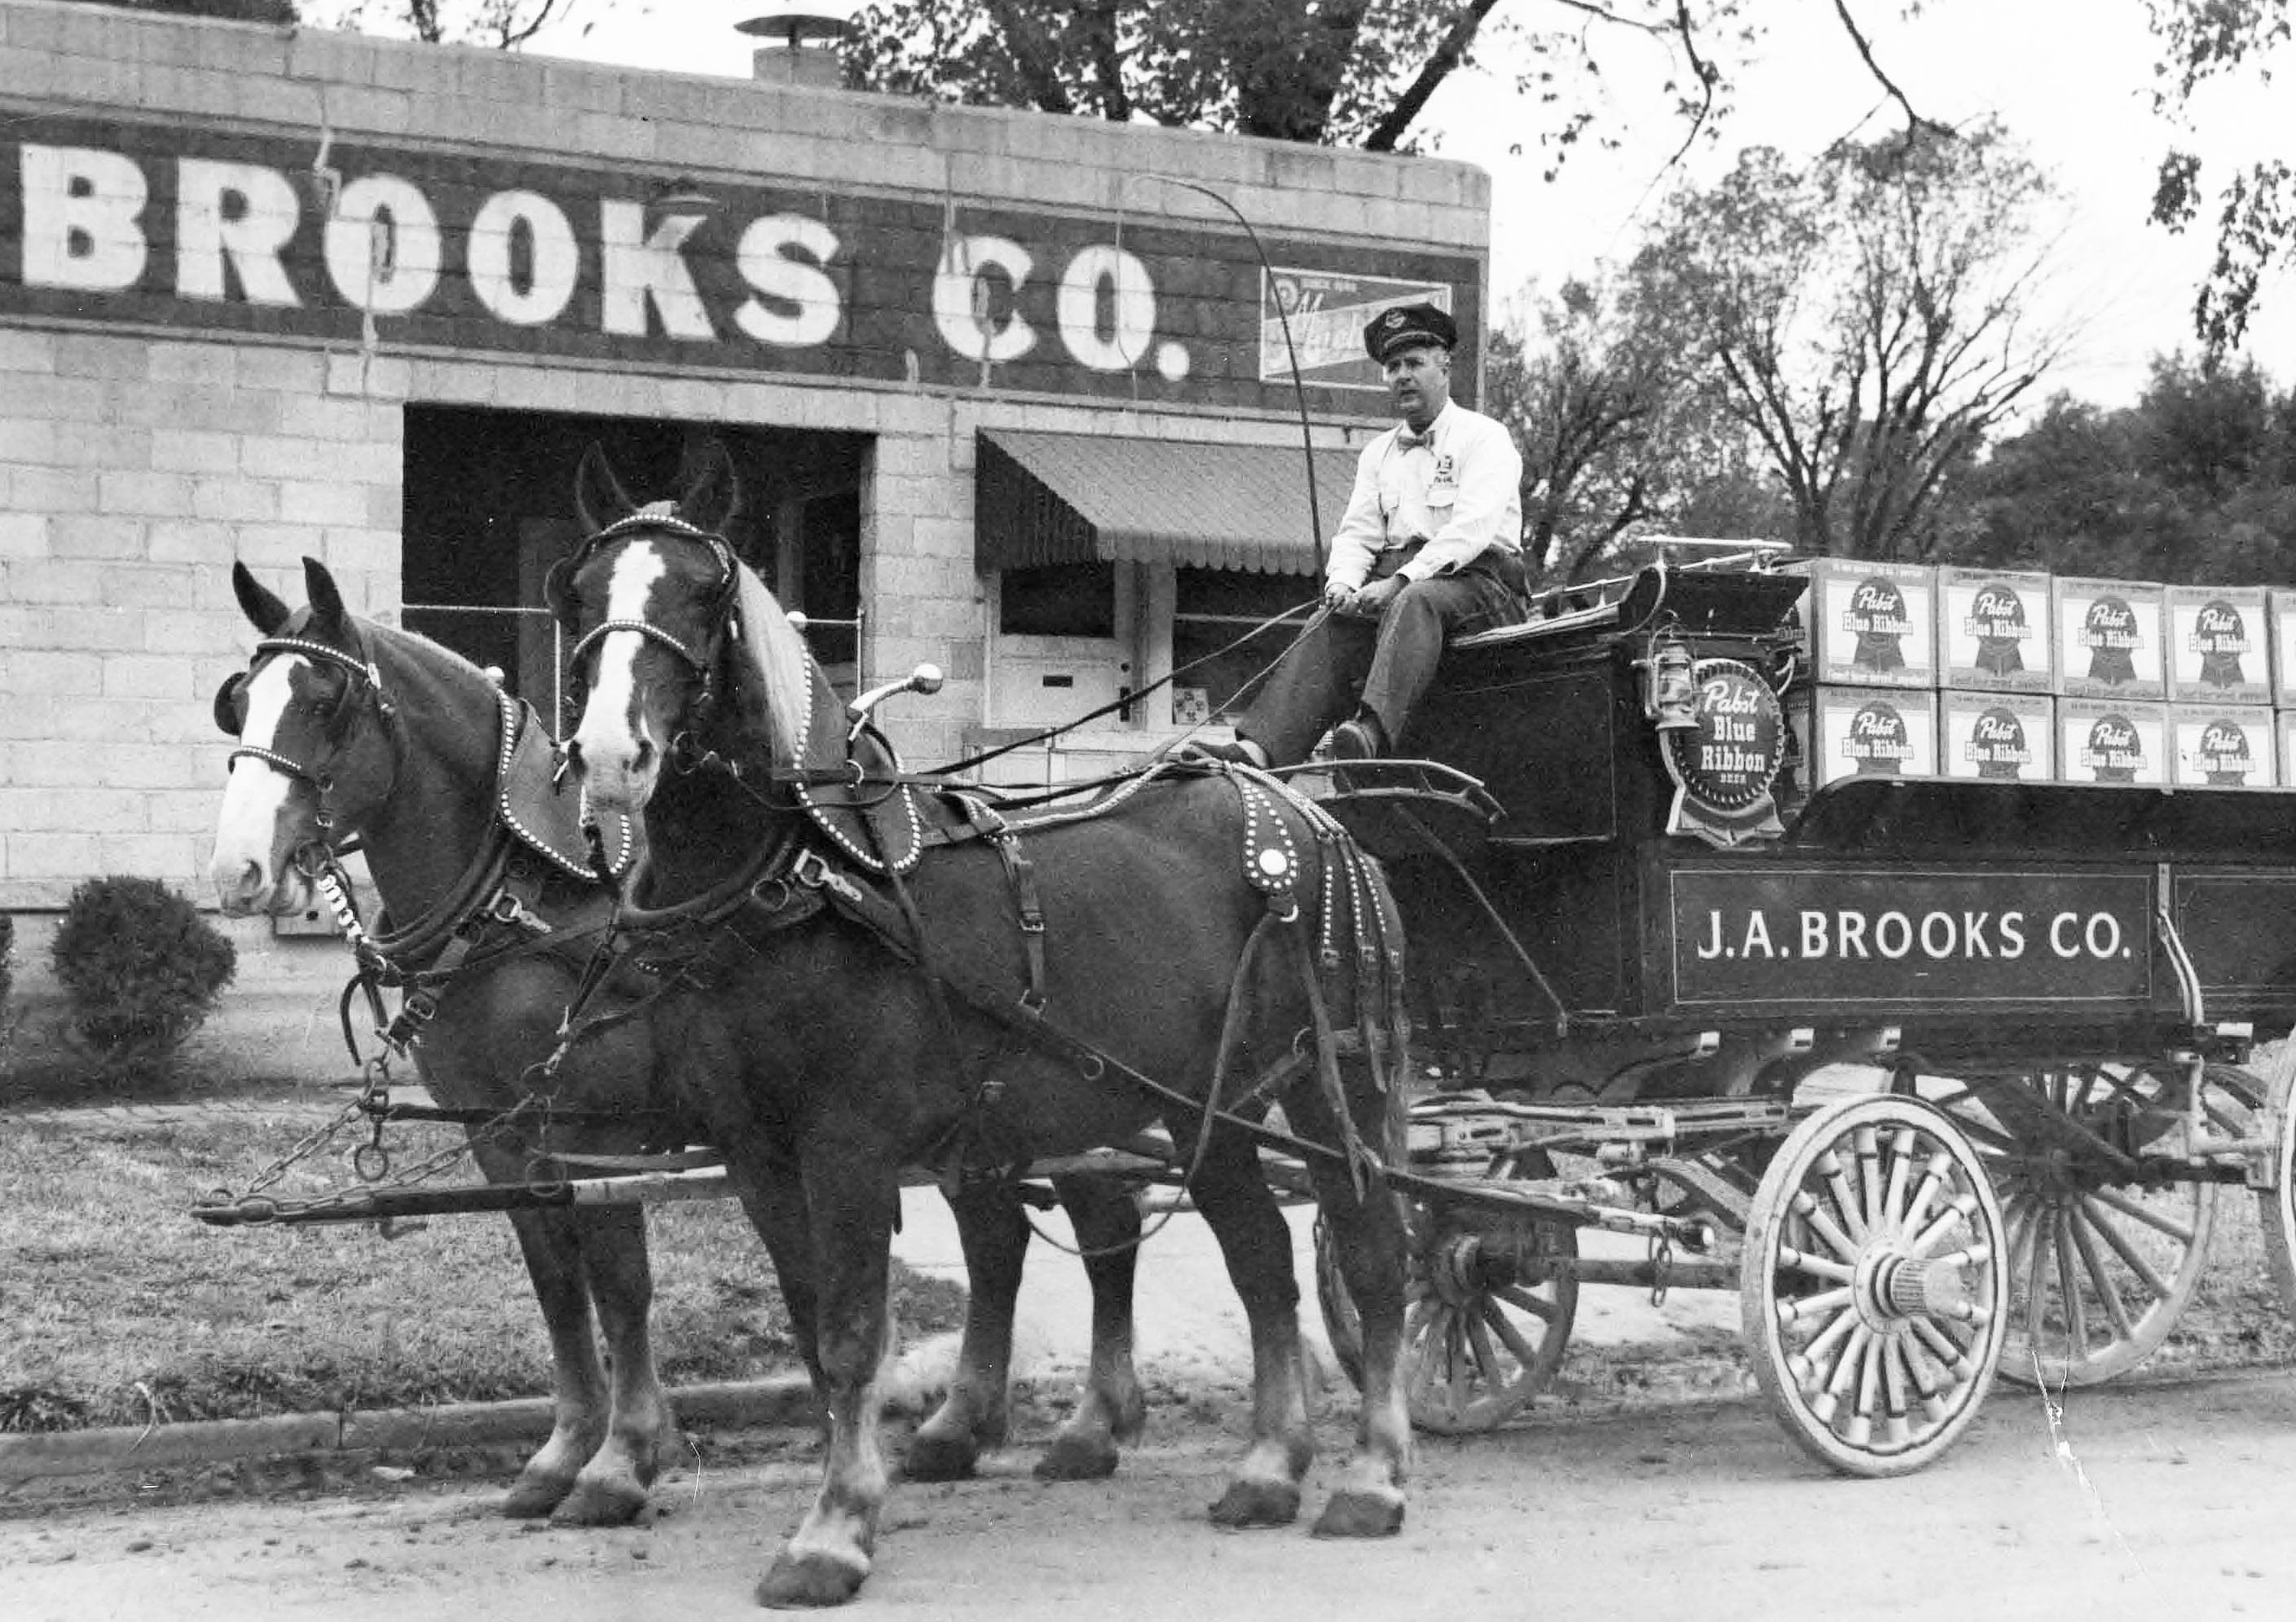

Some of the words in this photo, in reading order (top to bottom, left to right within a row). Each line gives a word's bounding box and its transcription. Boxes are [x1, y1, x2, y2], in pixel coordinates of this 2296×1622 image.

[19, 143, 841, 347] BROOKS
[932, 235, 1191, 381] CO.
[1858, 585, 1900, 611] Pabst
[1978, 593, 2019, 615] Pabst
[1843, 612, 1869, 632] Blue
[1873, 615, 1913, 634] Ribbon
[2092, 604, 2129, 626] Pabst
[2202, 609, 2237, 632] Pabst
[1965, 618, 1990, 636] Blue
[1994, 619, 2032, 638] Ribbon
[1703, 680, 1761, 714] Pabst
[1713, 716, 1756, 742] Blue
[1858, 712, 1900, 736] Pabst
[1980, 716, 2019, 740] Pabst
[2095, 723, 2132, 746] Pabst
[1842, 738, 1869, 757] Blue
[1873, 739, 1914, 759] Ribbon
[2206, 728, 2241, 750] Pabst
[1701, 745, 1765, 772] Ribbon
[1965, 742, 1991, 760] Blue
[1994, 743, 2031, 763] Ribbon
[2051, 912, 2131, 958] CO.
